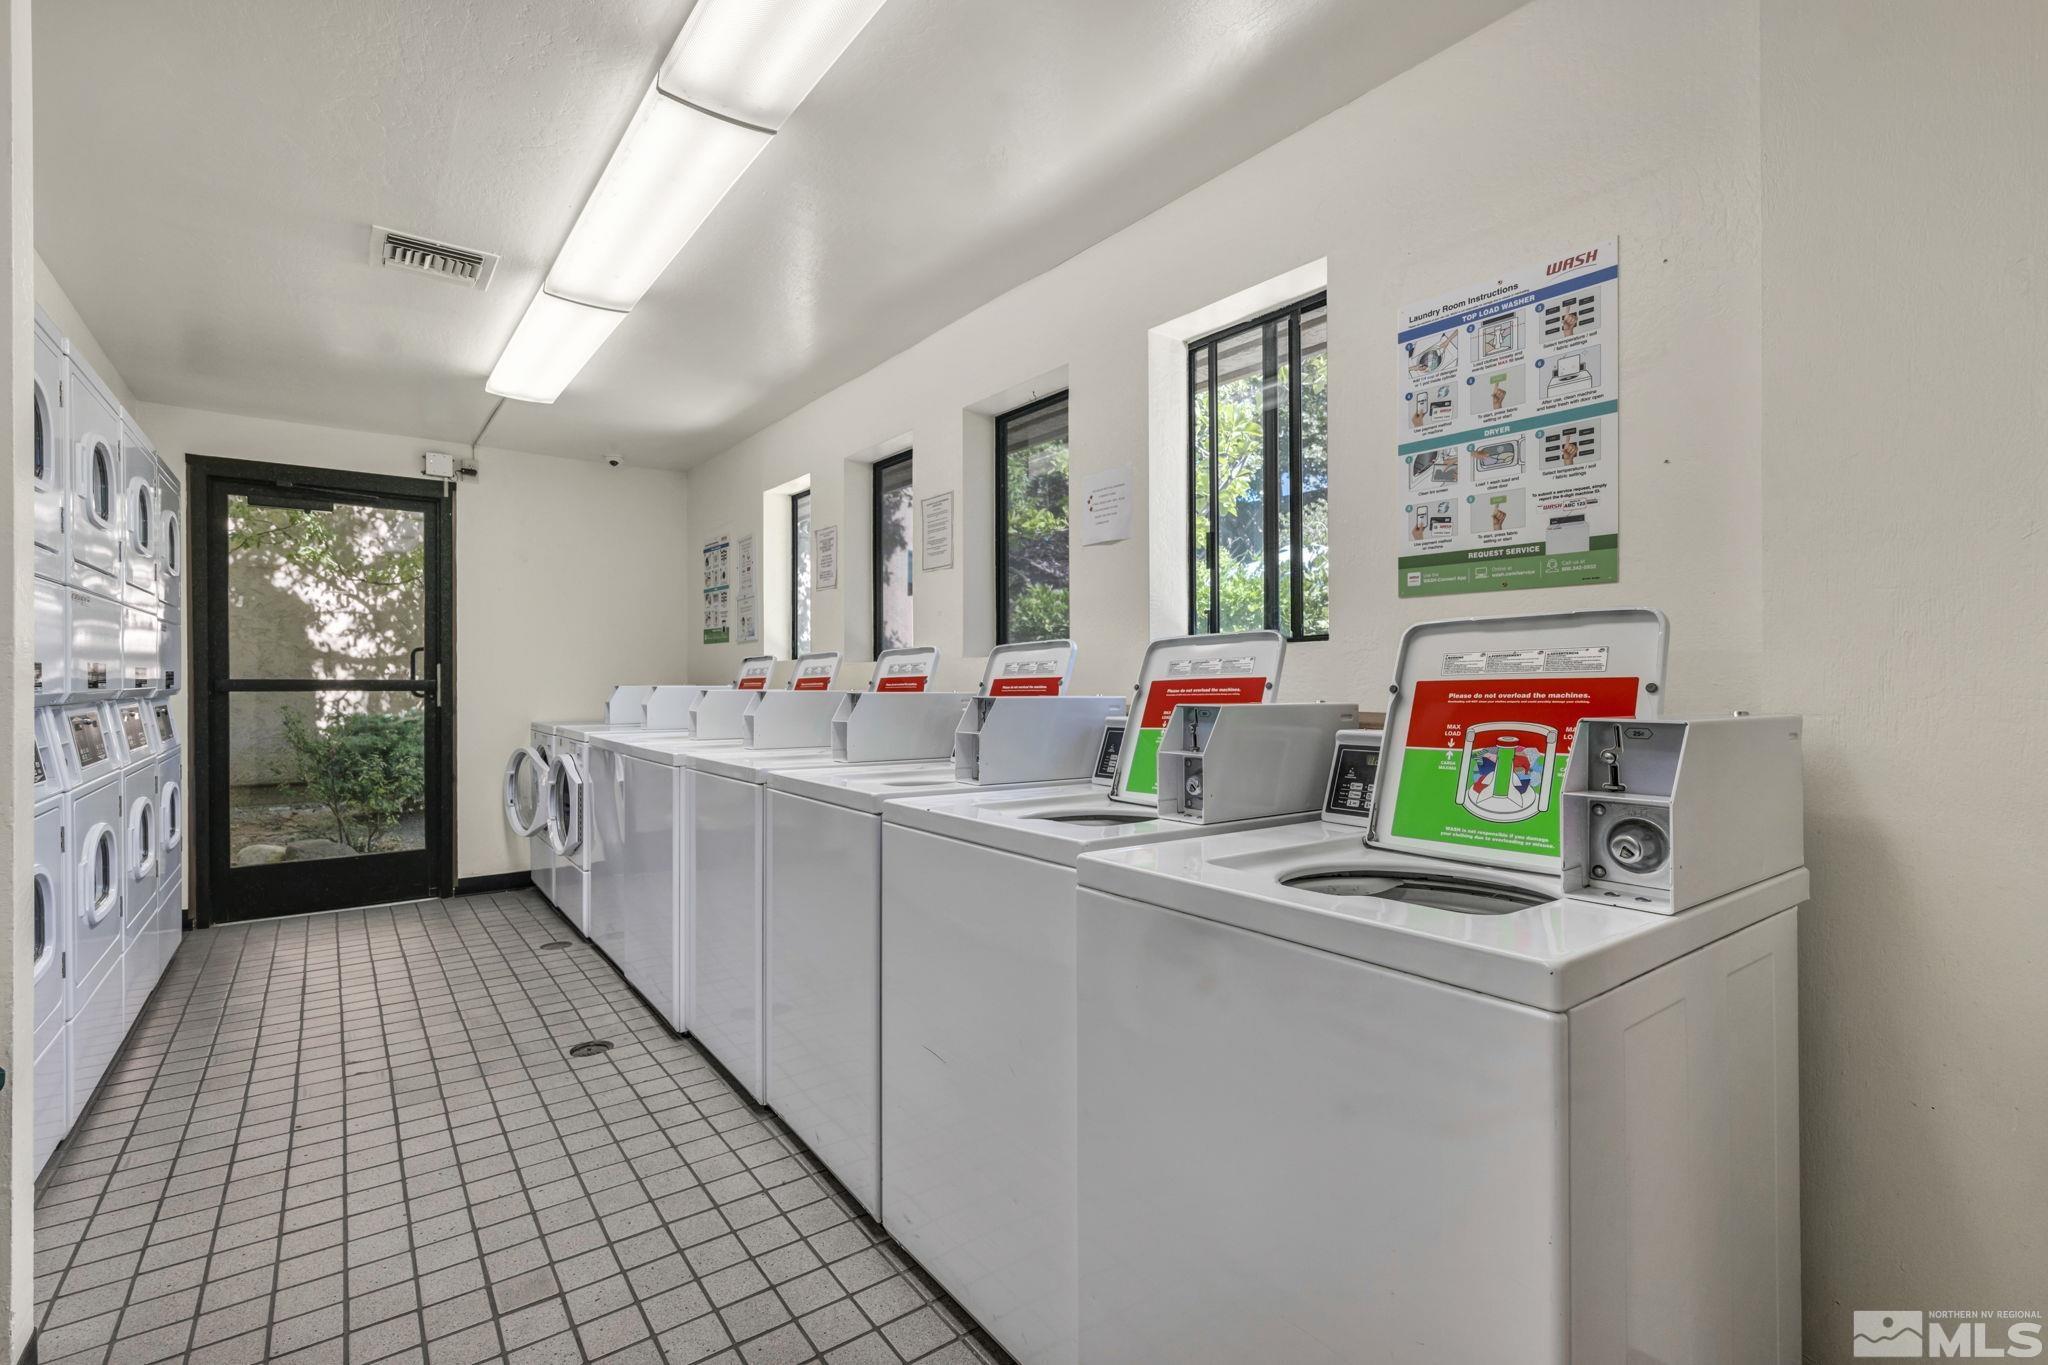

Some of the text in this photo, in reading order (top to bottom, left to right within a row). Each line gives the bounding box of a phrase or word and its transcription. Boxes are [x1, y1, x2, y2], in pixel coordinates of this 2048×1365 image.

[1546, 249, 1598, 276] WASH
[1408, 284, 1518, 323] Laundry Room Instructions
[1461, 295, 1535, 322] TOP LOAD WASHER
[1484, 426, 1510, 436] DRYER
[1468, 546, 1539, 558] REQUEST SERVICE
[1526, 835, 1549, 843] damage
